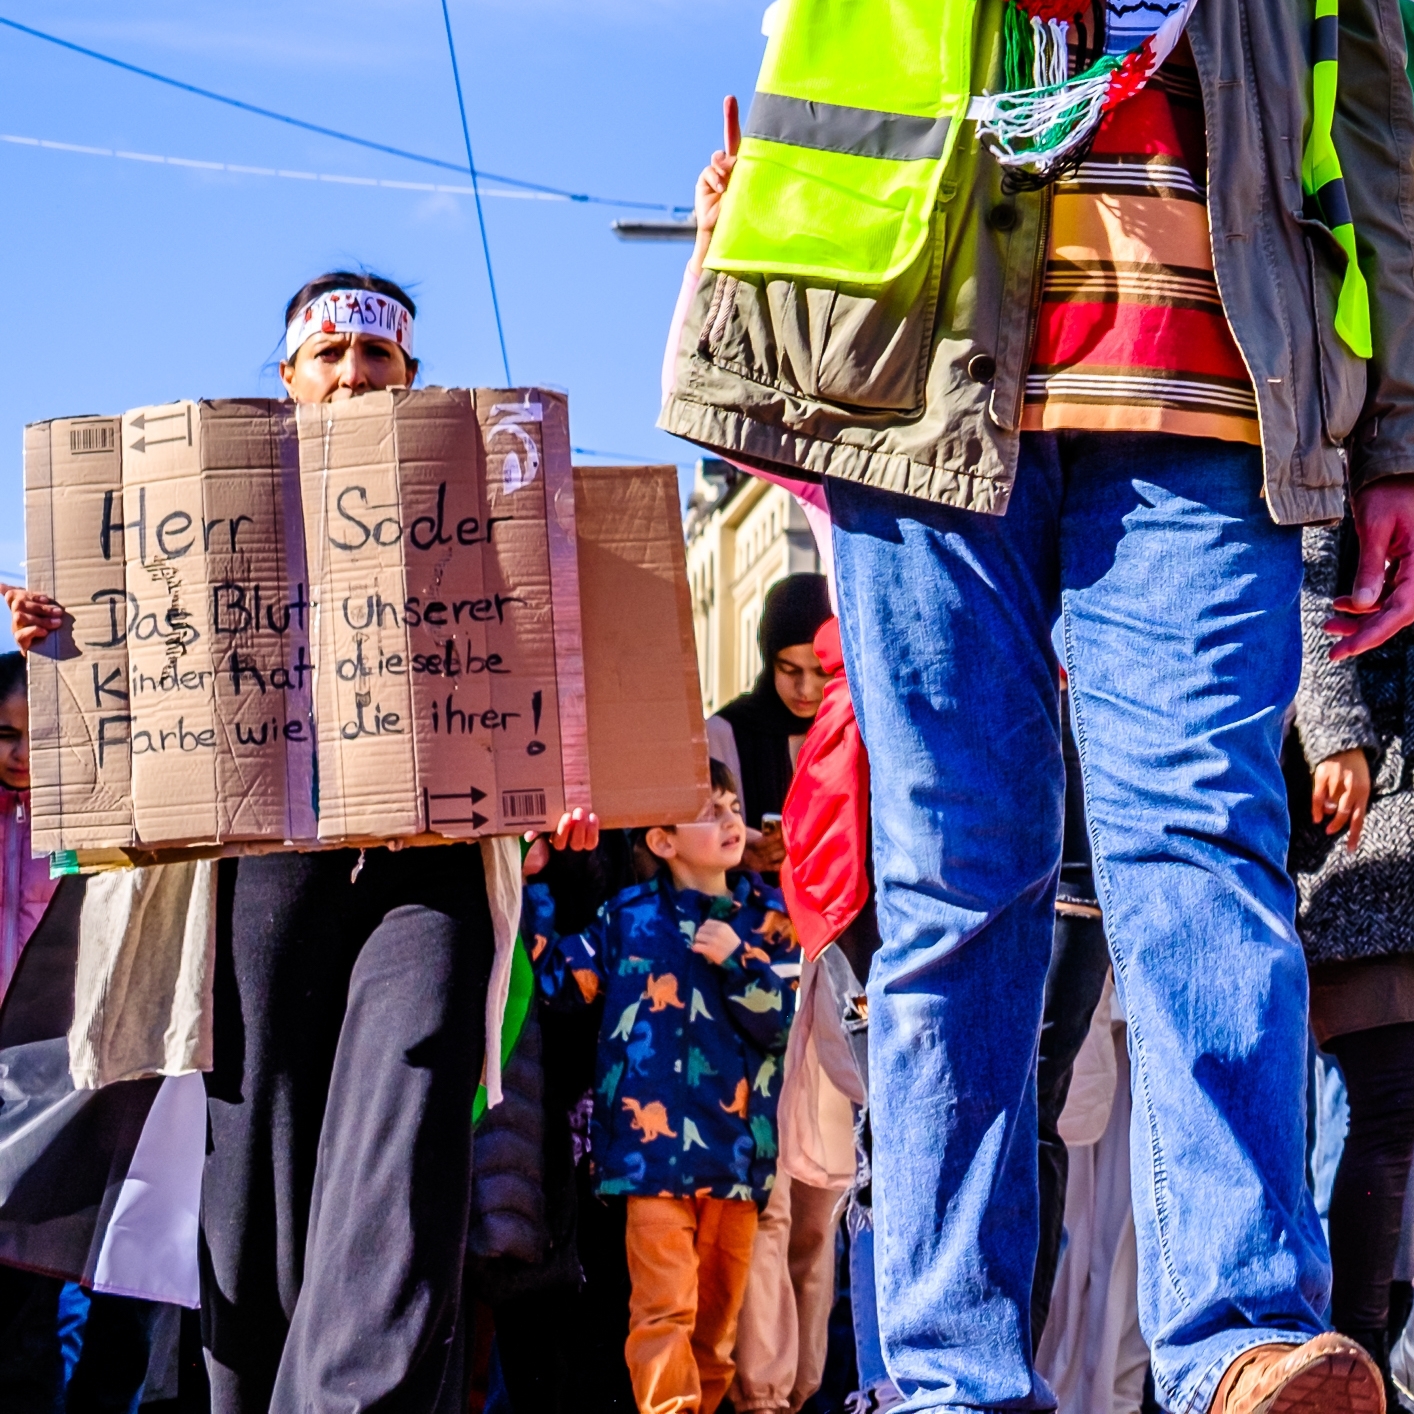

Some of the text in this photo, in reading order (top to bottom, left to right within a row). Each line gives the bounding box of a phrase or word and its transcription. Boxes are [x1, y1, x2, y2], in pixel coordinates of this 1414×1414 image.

[100, 487, 254, 565] Herr
[85, 589, 200, 648] Das
[213, 583, 308, 634] Blut
[92, 656, 212, 708] Kinder
[229, 646, 316, 696] hat
[98, 716, 217, 769] Farbe
[235, 717, 308, 745] wie
[341, 699, 405, 740] die
